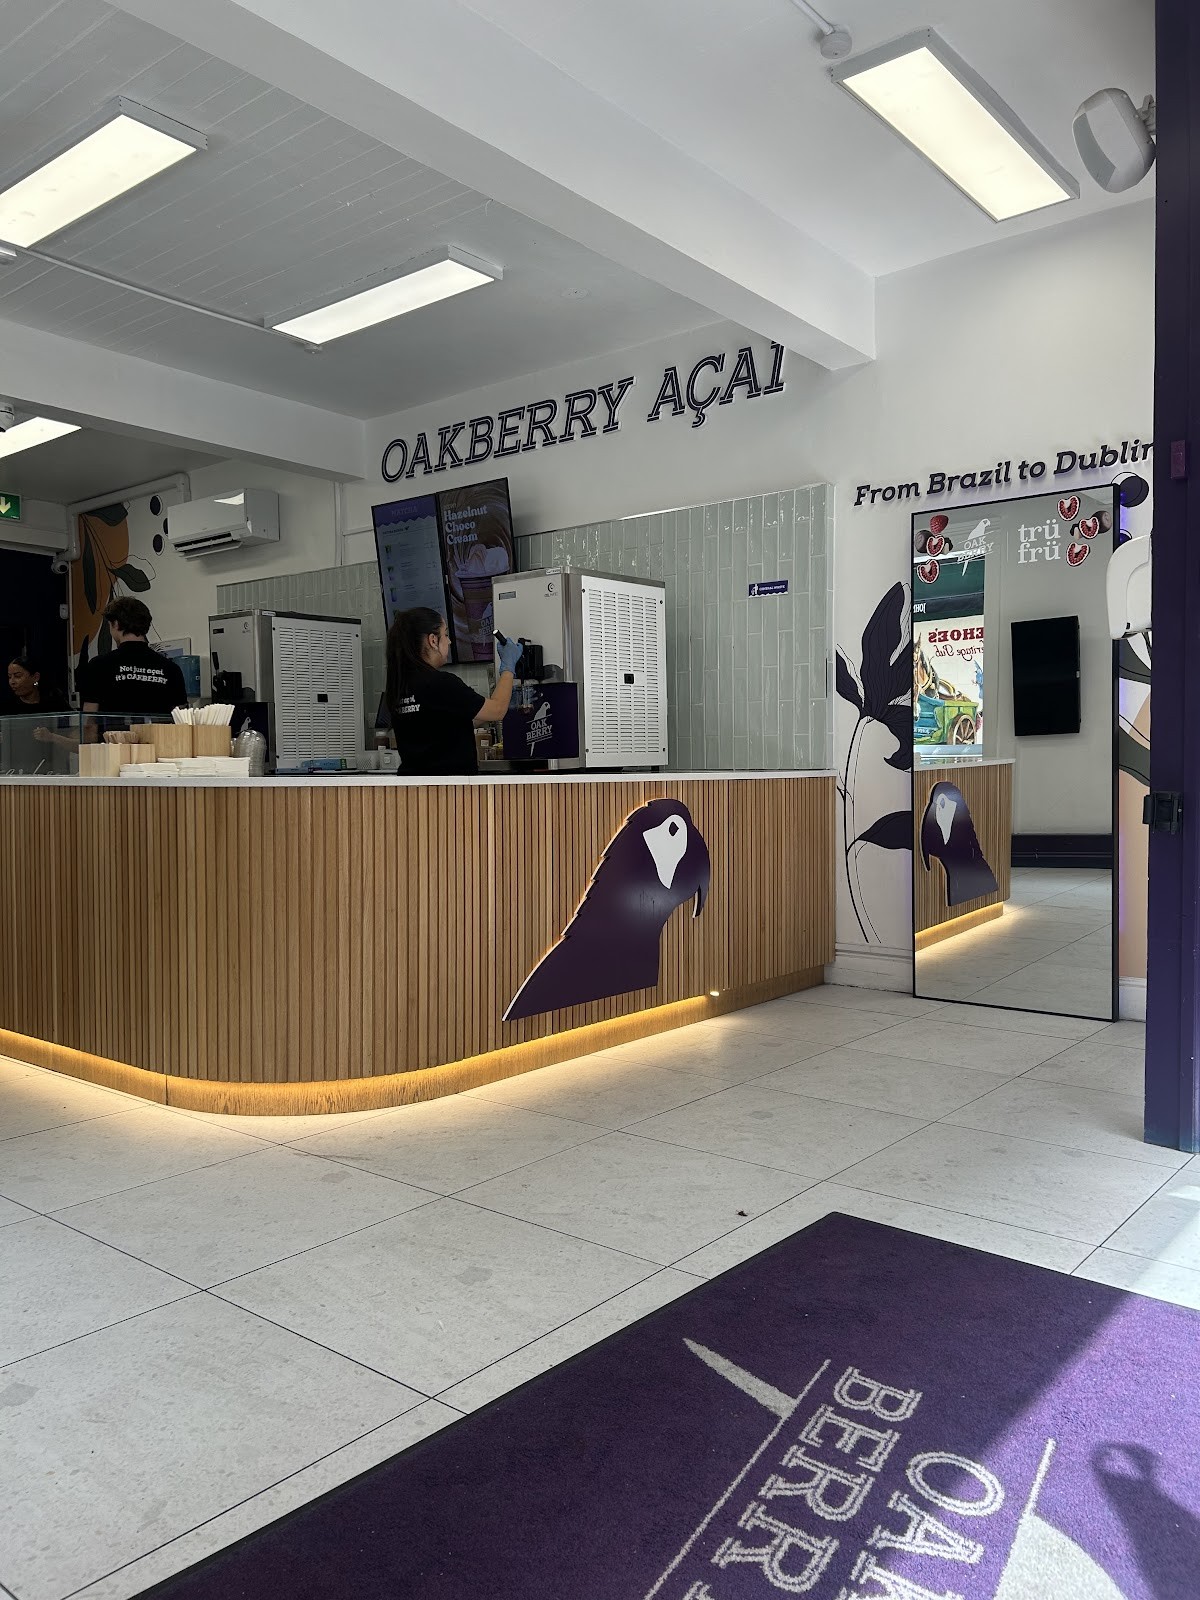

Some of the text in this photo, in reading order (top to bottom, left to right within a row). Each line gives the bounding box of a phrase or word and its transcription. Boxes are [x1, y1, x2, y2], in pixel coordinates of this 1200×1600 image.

[381, 376, 635, 483] OAKBERRY
[854, 485, 920, 507] From
[927, 462, 1011, 496] Brazil
[1018, 459, 1046, 479] to
[443, 504, 488, 522] Hazelnut
[445, 521, 476, 534] Choco
[1018, 518, 1061, 542] trü
[446, 533, 478, 546] Cream
[963, 536, 987, 550] OAK
[1018, 541, 1061, 564] frü
[119, 665, 133, 673] Not
[526, 724, 552, 740] BERRY
[530, 719, 547, 730] OAK
